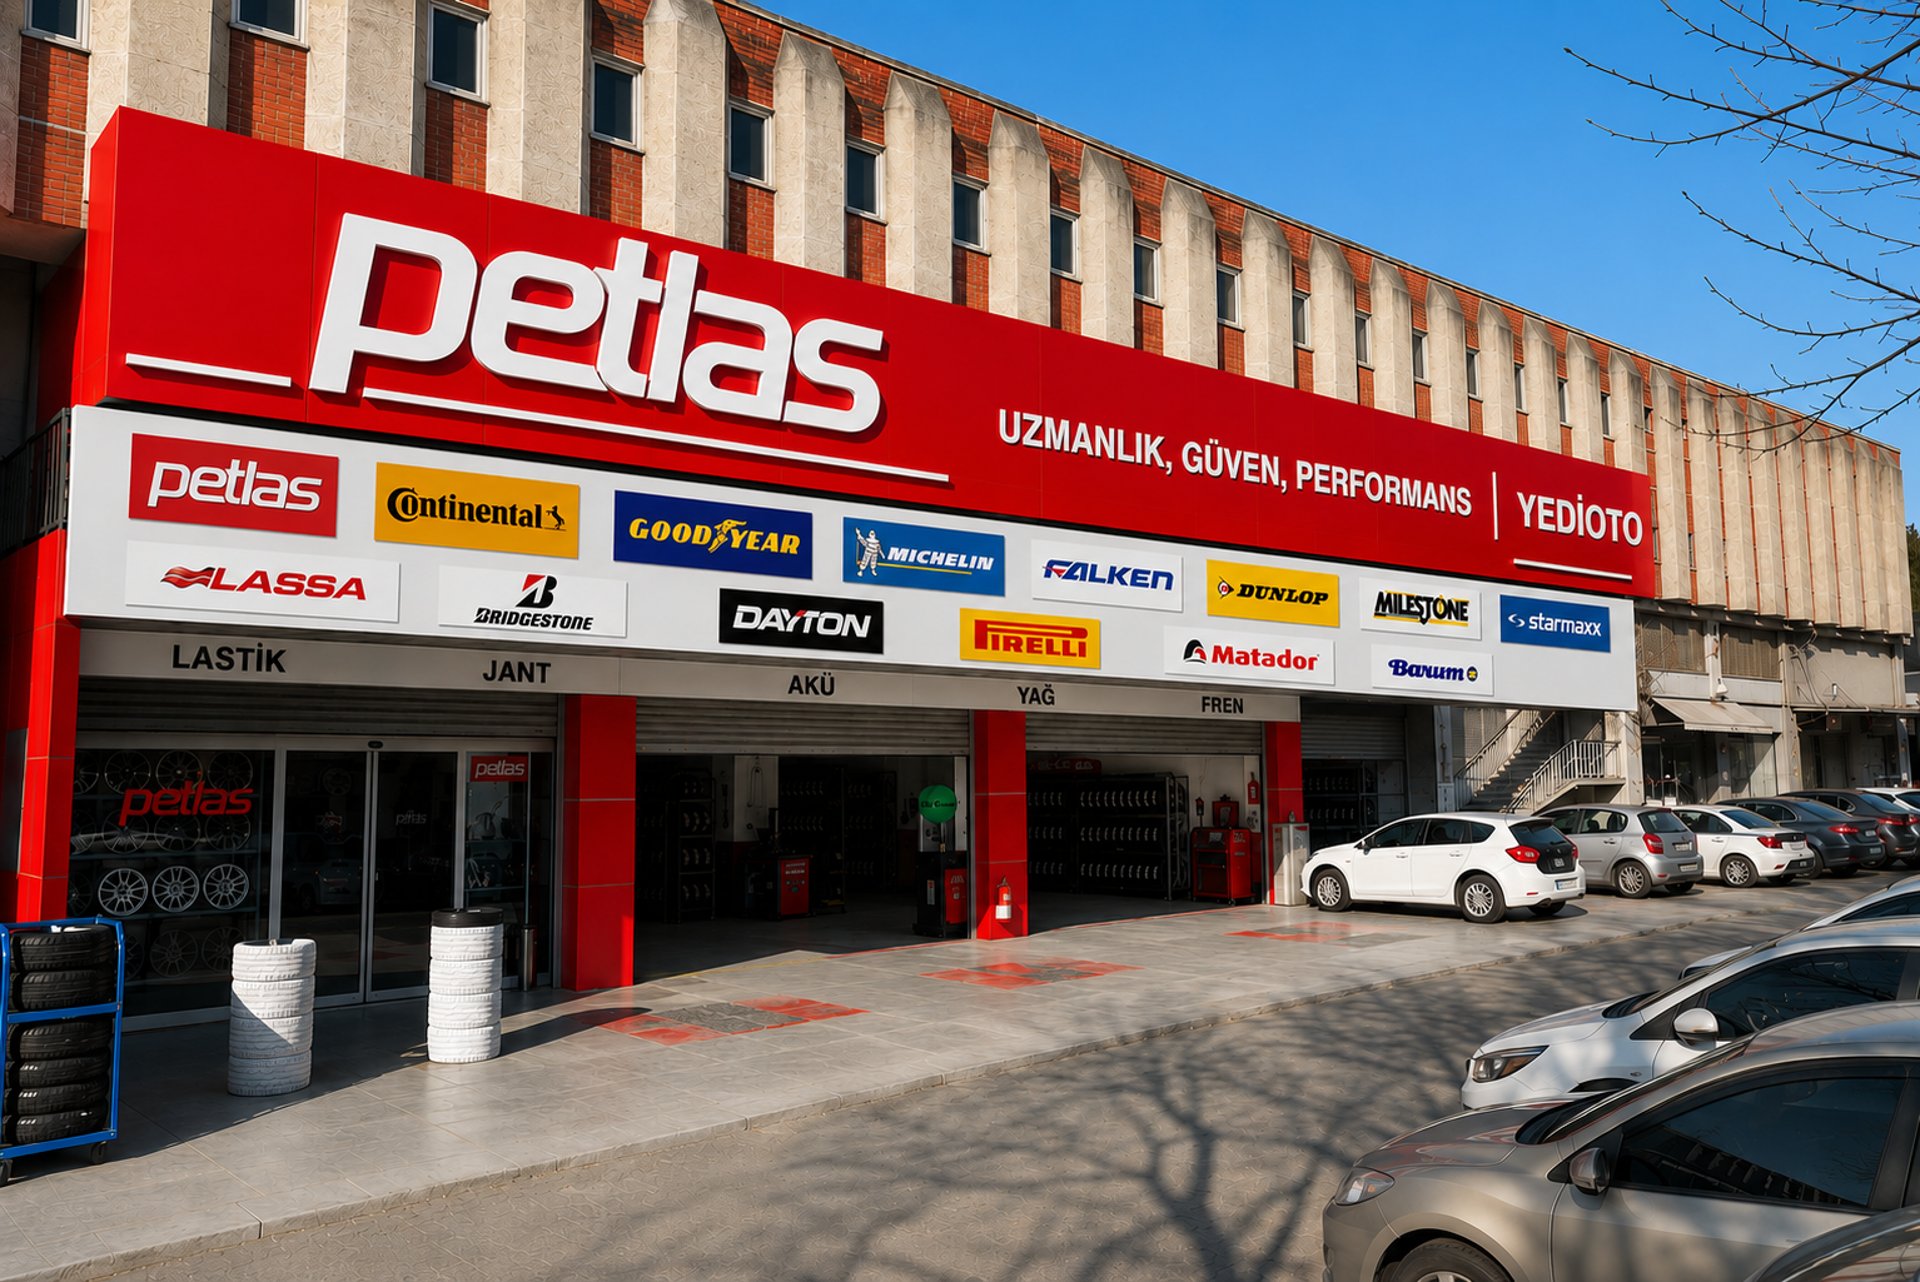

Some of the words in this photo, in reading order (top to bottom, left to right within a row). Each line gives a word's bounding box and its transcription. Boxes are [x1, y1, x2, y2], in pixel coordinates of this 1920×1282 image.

[308, 212, 884, 433] petlas
[998, 408, 1173, 475] UZMANLIK,
[1181, 438, 1287, 493] GÜVEN,
[1295, 459, 1473, 517] PERFORMANS
[147, 458, 323, 512] petlas
[387, 486, 543, 529] Continental
[1516, 491, 1644, 547] YEDİOTO
[887, 546, 995, 572] MICHELIN
[209, 566, 367, 602] LASSA
[1042, 558, 1175, 592] FALKEN
[1236, 583, 1329, 606] DUNLOP
[1374, 590, 1470, 626] MILESTONE
[473, 607, 595, 631] BRIDGESTONE
[732, 604, 872, 638] DAYTON
[1528, 612, 1602, 637] starmaxx
[973, 618, 1089, 658] PIRELLI
[171, 642, 287, 673] LASTİK
[482, 659, 552, 684] JANT
[1211, 644, 1319, 671] Matador
[1388, 658, 1465, 681] Barum
[787, 672, 836, 696] AKÜ
[1016, 683, 1056, 706] YAĞ
[1201, 695, 1244, 714] FREN
[475, 759, 525, 779] petlas
[118, 779, 254, 827] petlas
